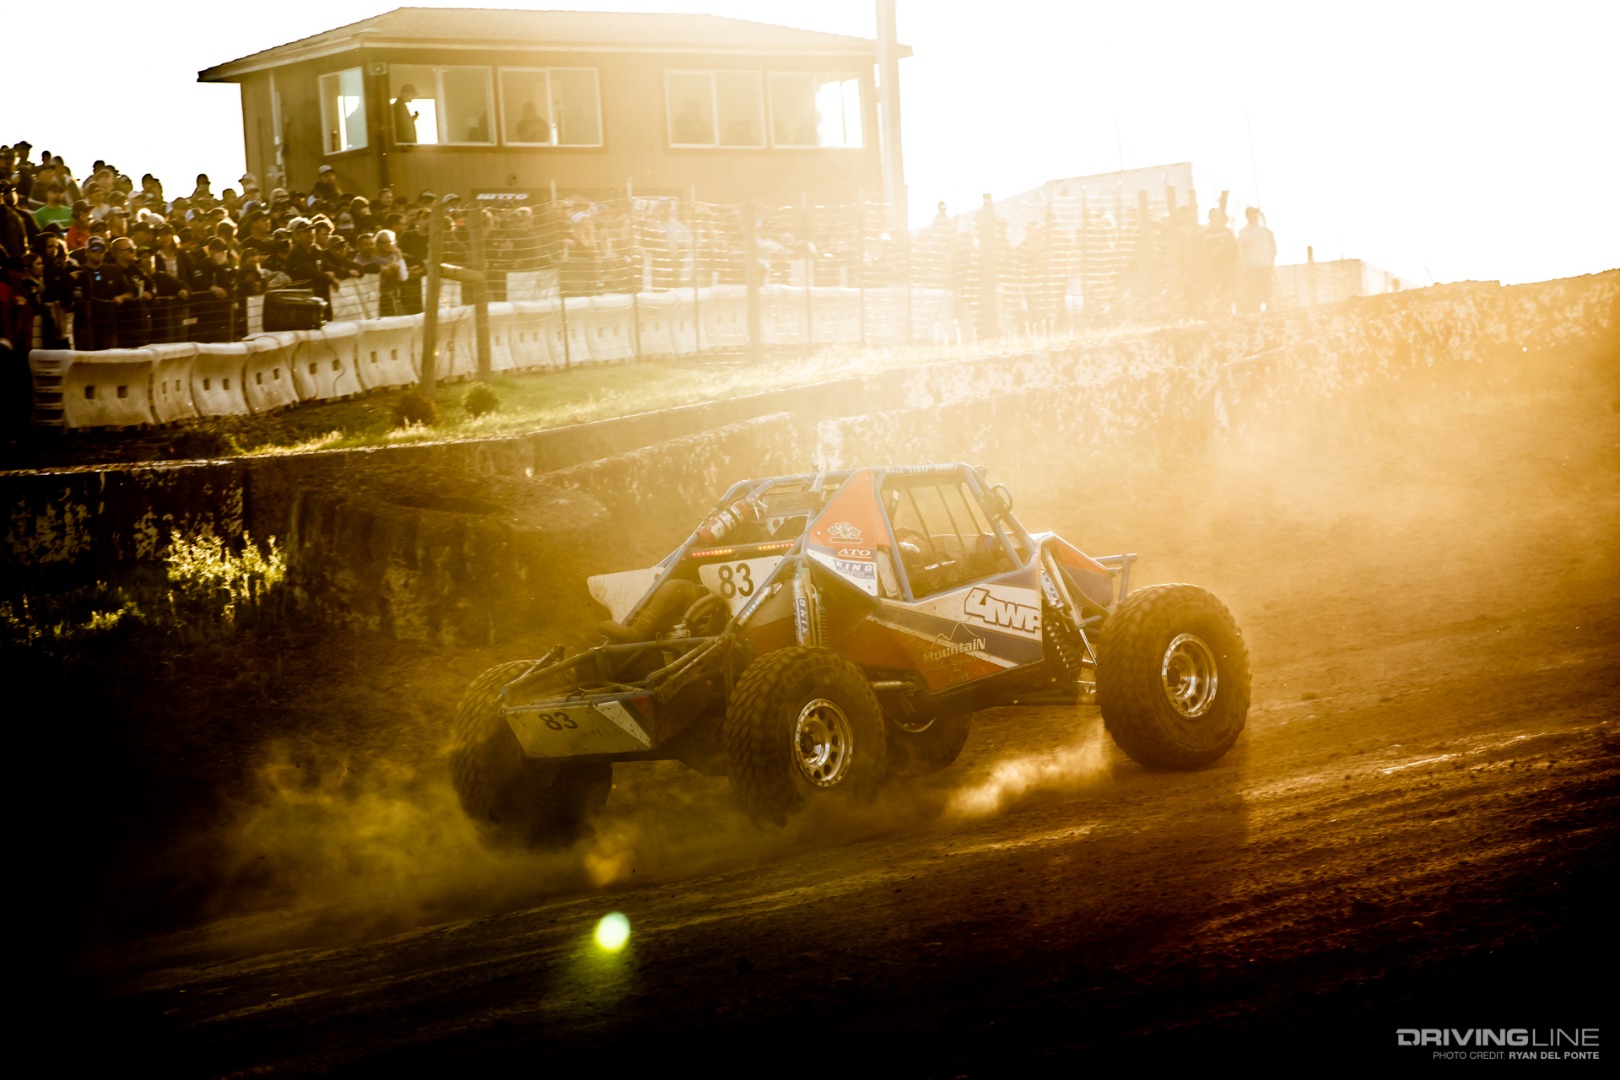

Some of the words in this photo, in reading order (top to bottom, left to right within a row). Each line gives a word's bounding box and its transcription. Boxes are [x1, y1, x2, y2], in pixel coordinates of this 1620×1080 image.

[837, 548, 871, 557] ATO
[835, 561, 873, 573] KING
[718, 563, 755, 599] 83
[964, 587, 1041, 634] 4WP
[538, 711, 579, 731] 83
